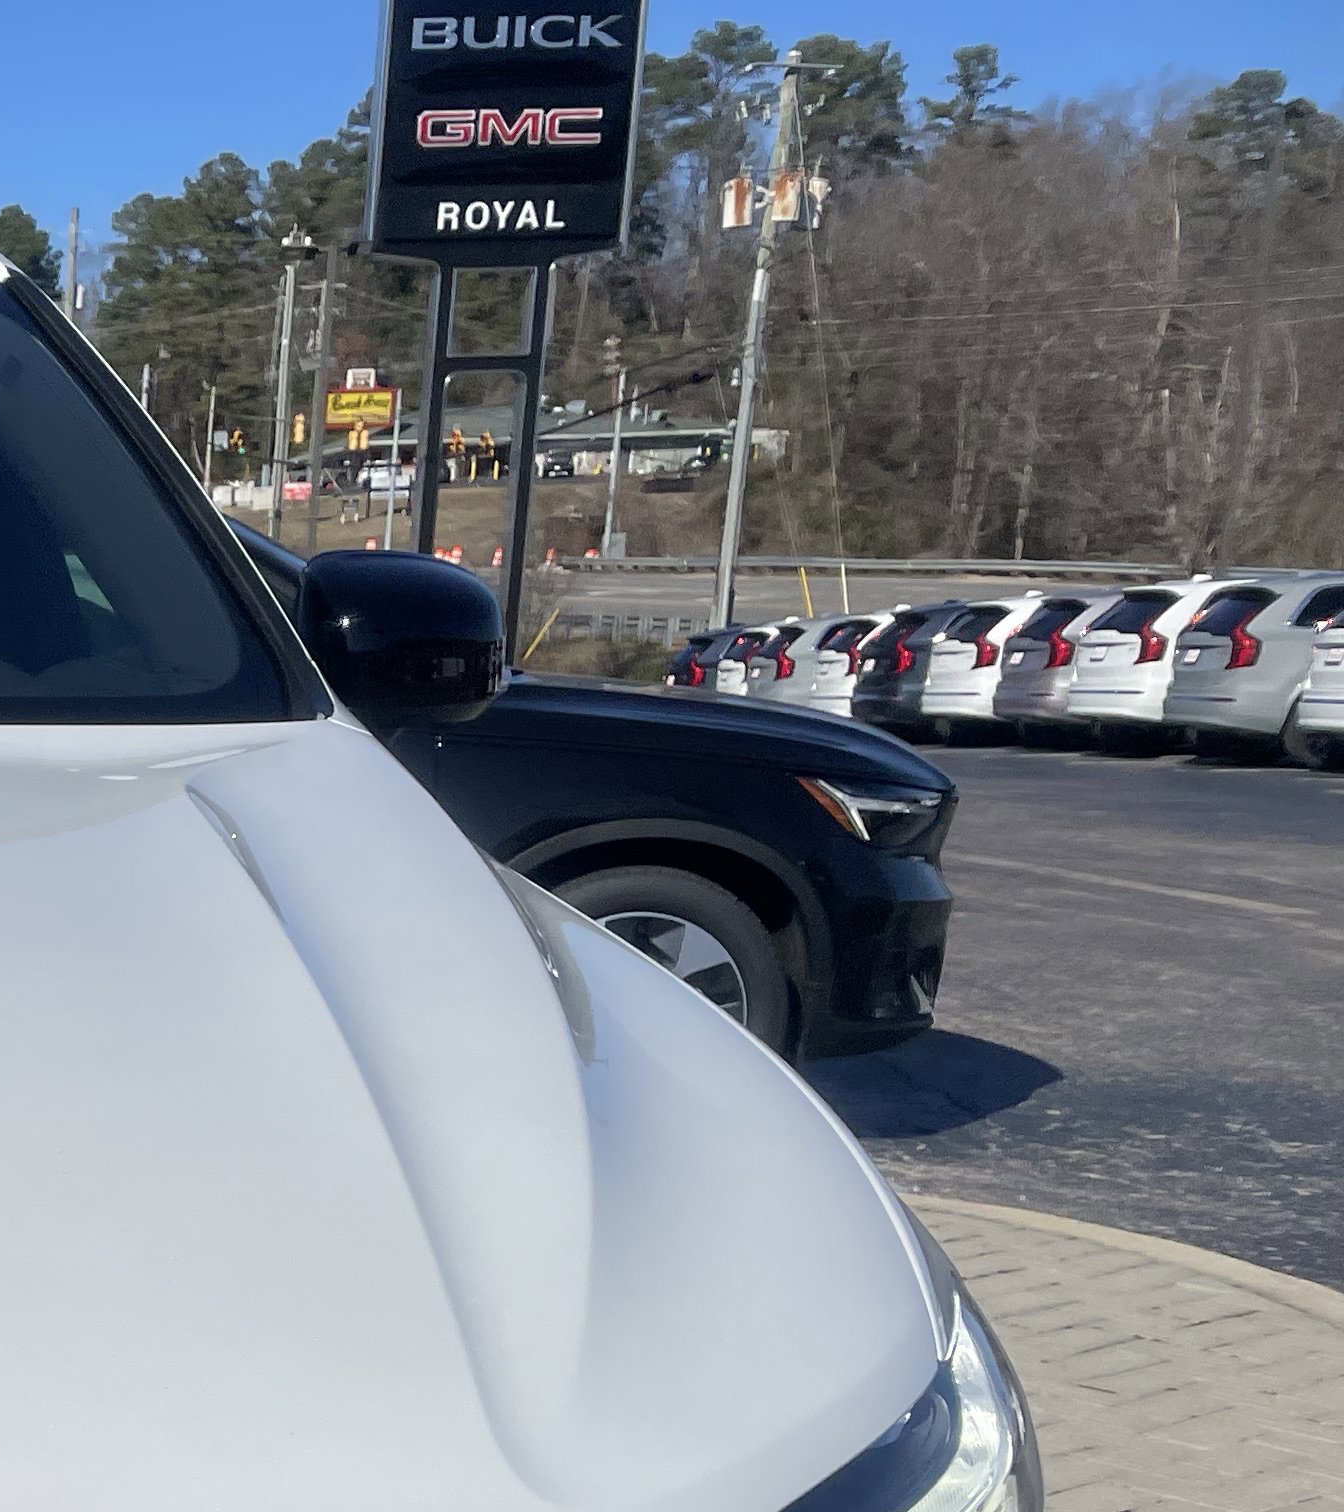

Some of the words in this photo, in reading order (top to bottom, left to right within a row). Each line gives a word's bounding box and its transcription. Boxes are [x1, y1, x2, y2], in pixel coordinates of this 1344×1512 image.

[412, 15, 622, 50] BUICK
[416, 107, 603, 147] GMC
[436, 200, 565, 231] ROYAL
